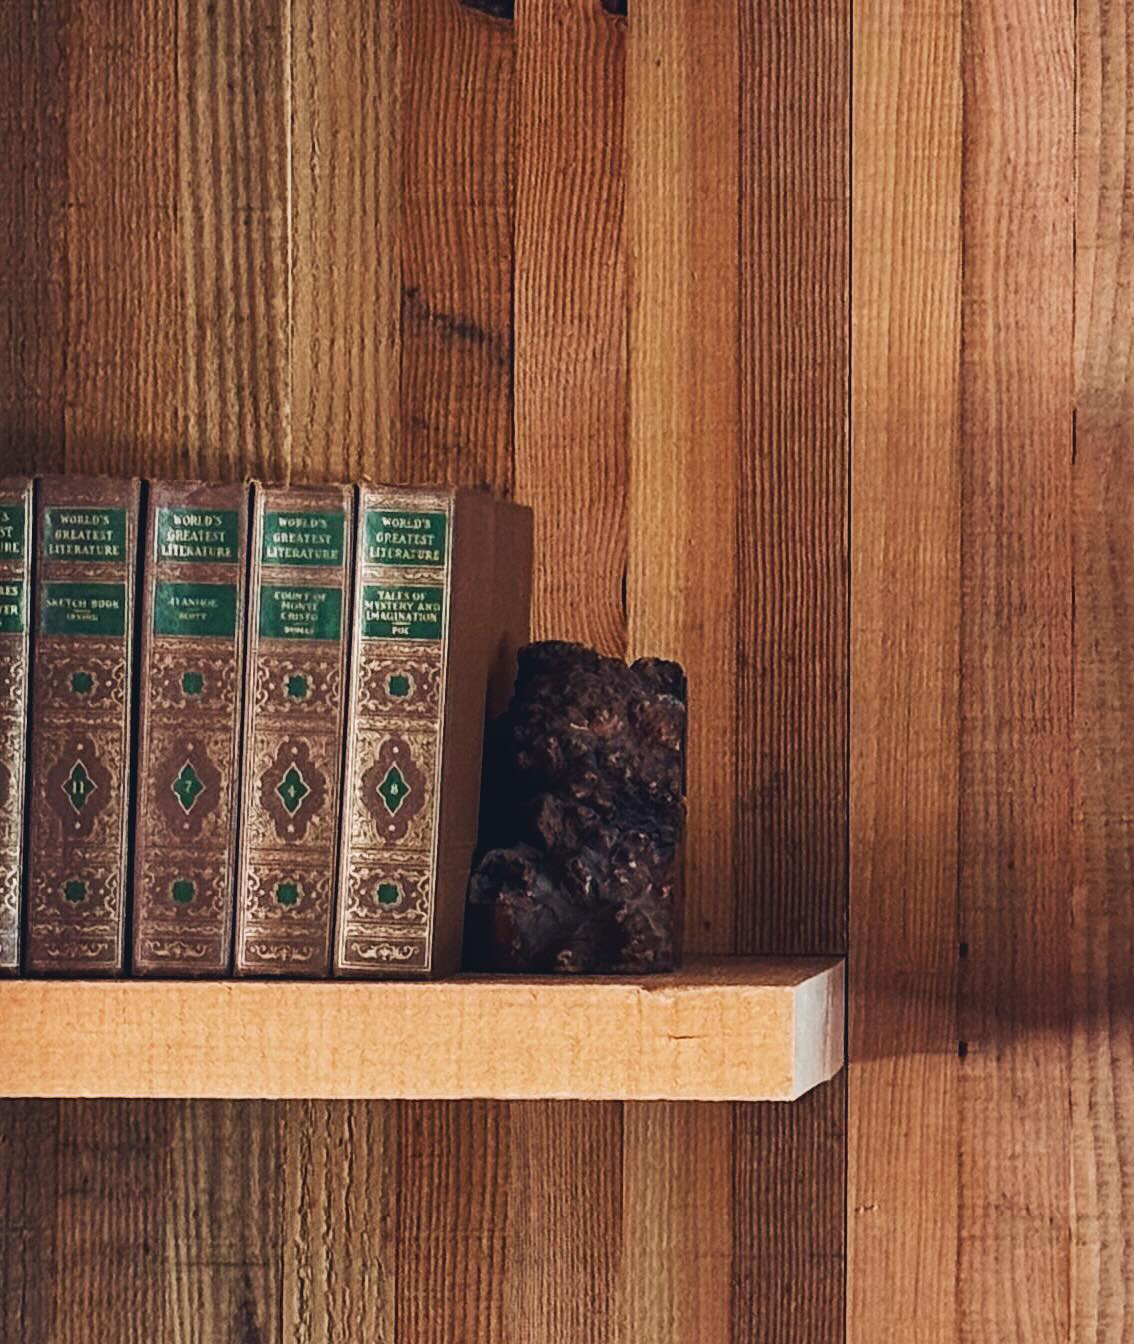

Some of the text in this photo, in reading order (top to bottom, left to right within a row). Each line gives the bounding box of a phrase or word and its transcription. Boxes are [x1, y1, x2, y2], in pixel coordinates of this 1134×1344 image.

[60, 514, 109, 524] WORLD'S
[174, 514, 222, 526] WORLD'S
[278, 518, 327, 528] WORLD'S
[382, 518, 431, 528] WORLD'S
[55, 530, 113, 541] GREATEST
[167, 530, 225, 542] GREATEST
[273, 532, 332, 544] GREATEST
[376, 532, 434, 545] GREATEST
[49, 544, 119, 555] LITERATURE
[162, 544, 231, 557] LITERATURE
[267, 547, 338, 559] LITERATURE
[370, 547, 439, 560] LITERATURE
[378, 591, 425, 601] TALES OF
[365, 601, 440, 611] MYSTERY AND
[366, 611, 437, 622] IMAGINATION
[72, 781, 85, 794] 11
[184, 781, 192, 793] 7
[287, 785, 296, 798] 4
[390, 783, 398, 795] 8
